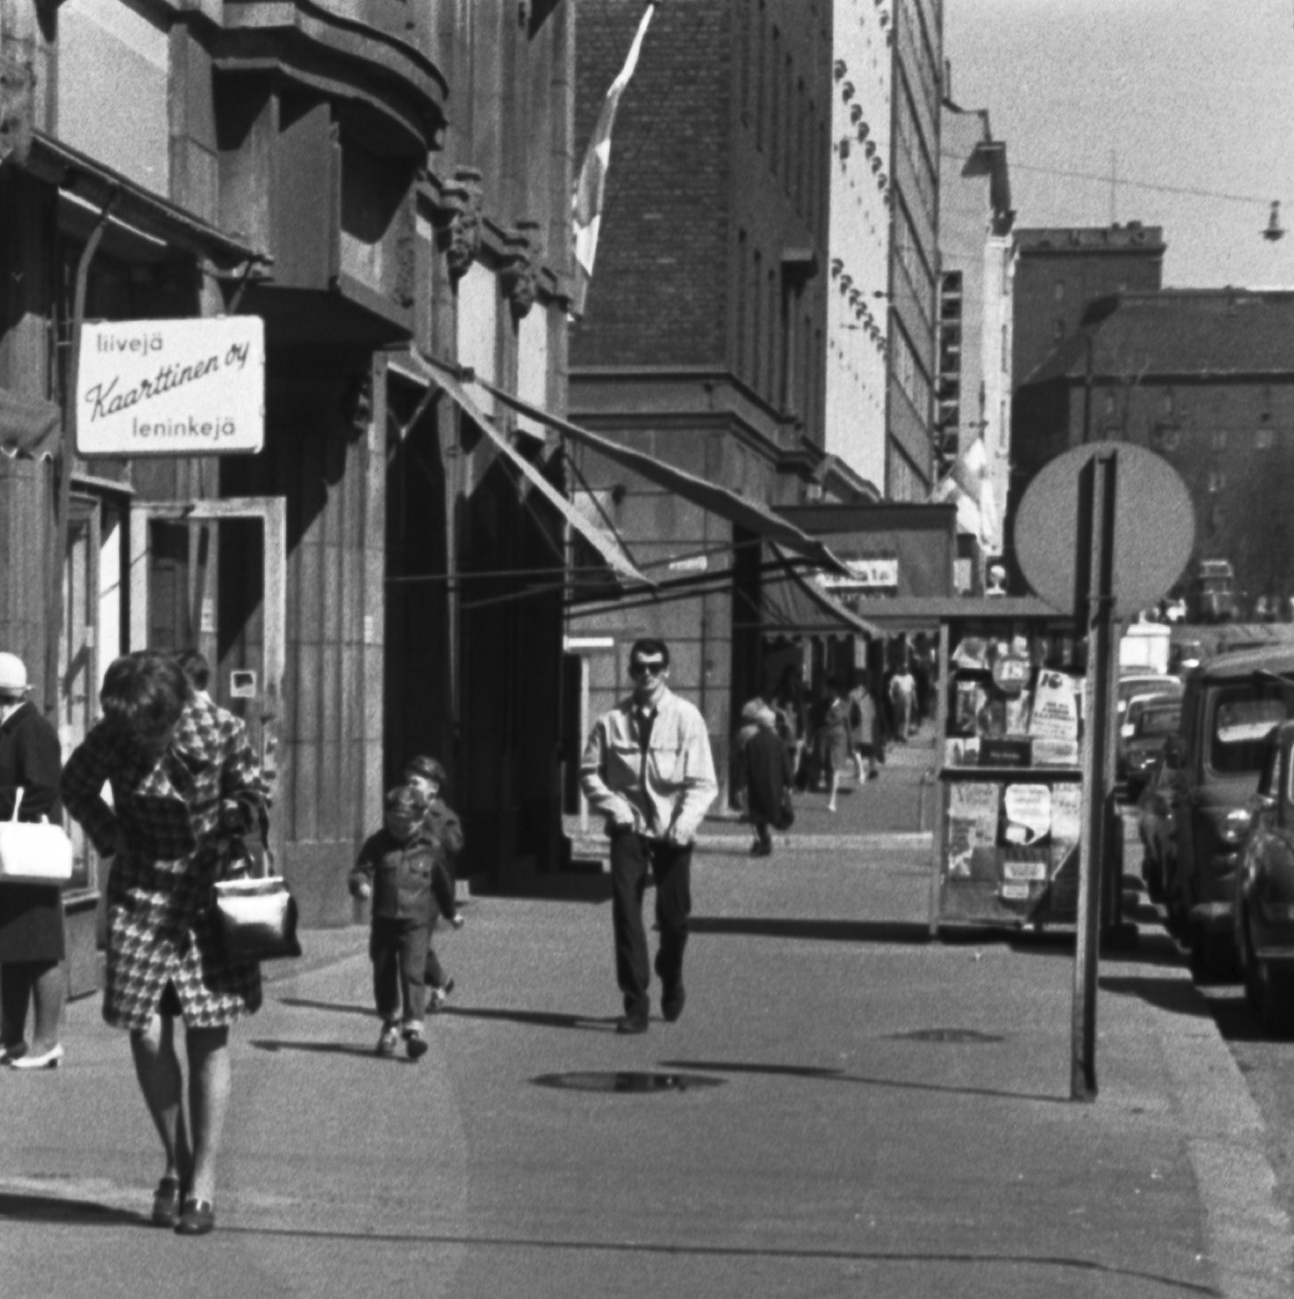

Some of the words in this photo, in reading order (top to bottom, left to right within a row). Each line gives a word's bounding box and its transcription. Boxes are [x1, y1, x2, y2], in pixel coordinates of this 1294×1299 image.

[97, 332, 163, 356] liivejä
[85, 355, 219, 422] Kaarttinen
[132, 415, 235, 440] leninkejä
